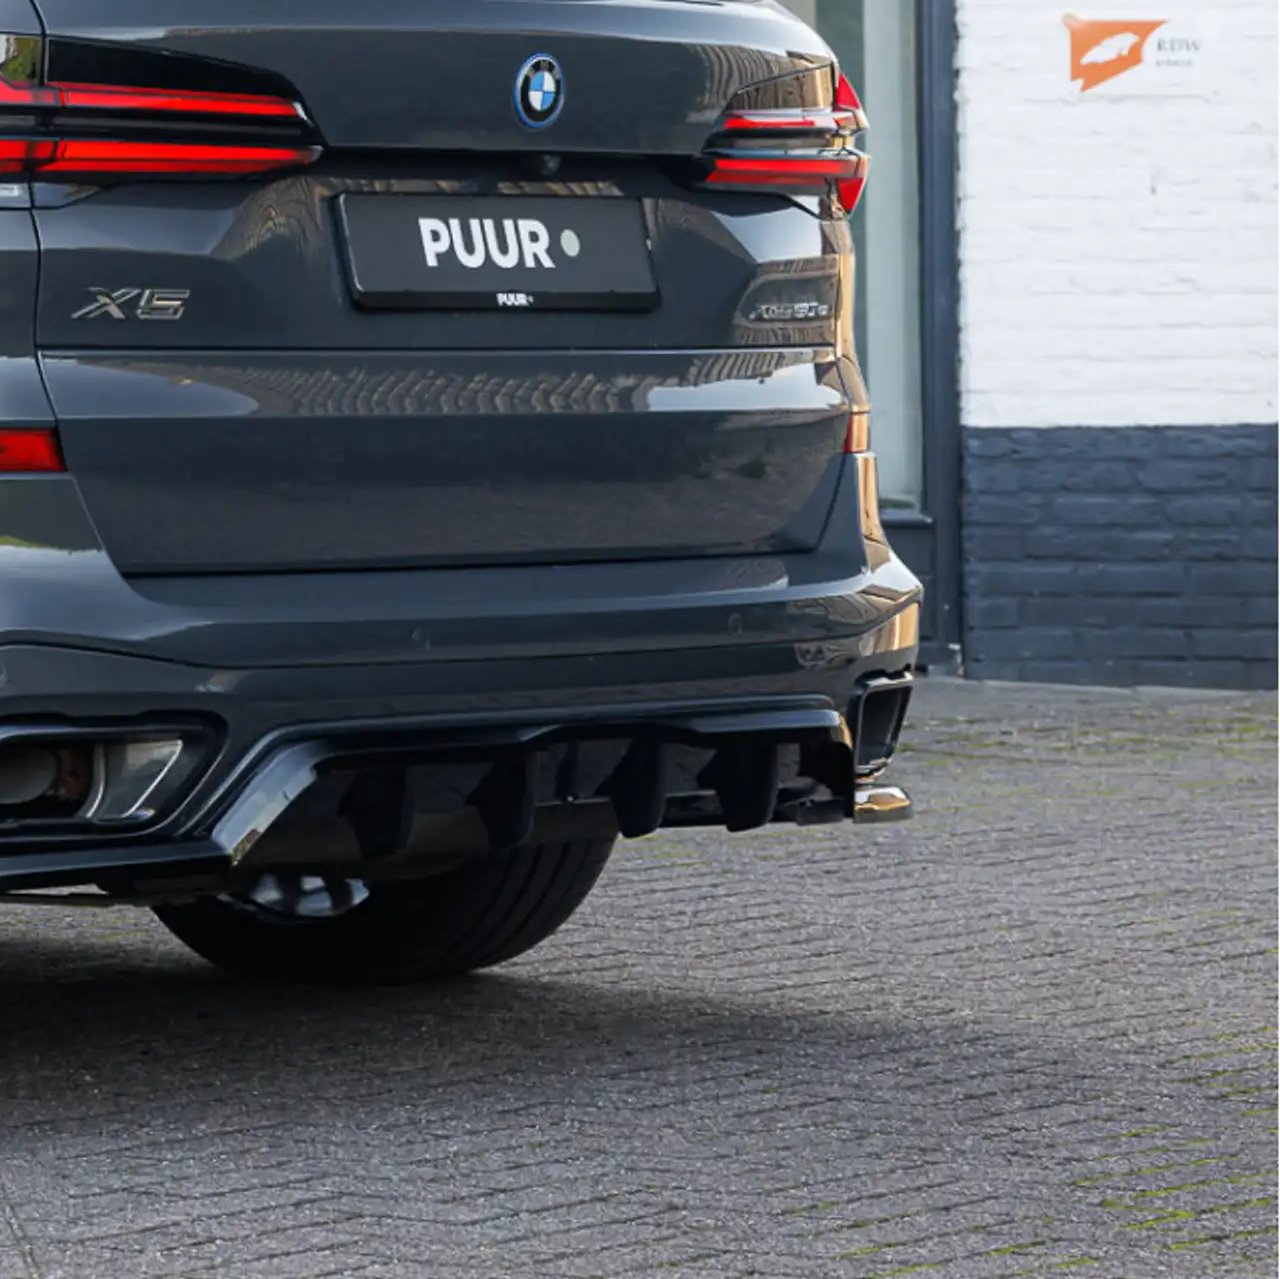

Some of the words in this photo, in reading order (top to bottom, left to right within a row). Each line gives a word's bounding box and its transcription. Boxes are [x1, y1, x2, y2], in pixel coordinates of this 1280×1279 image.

[418, 217, 556, 268] PUUR
[71, 286, 191, 320] X5
[496, 292, 530, 307] PUUR
